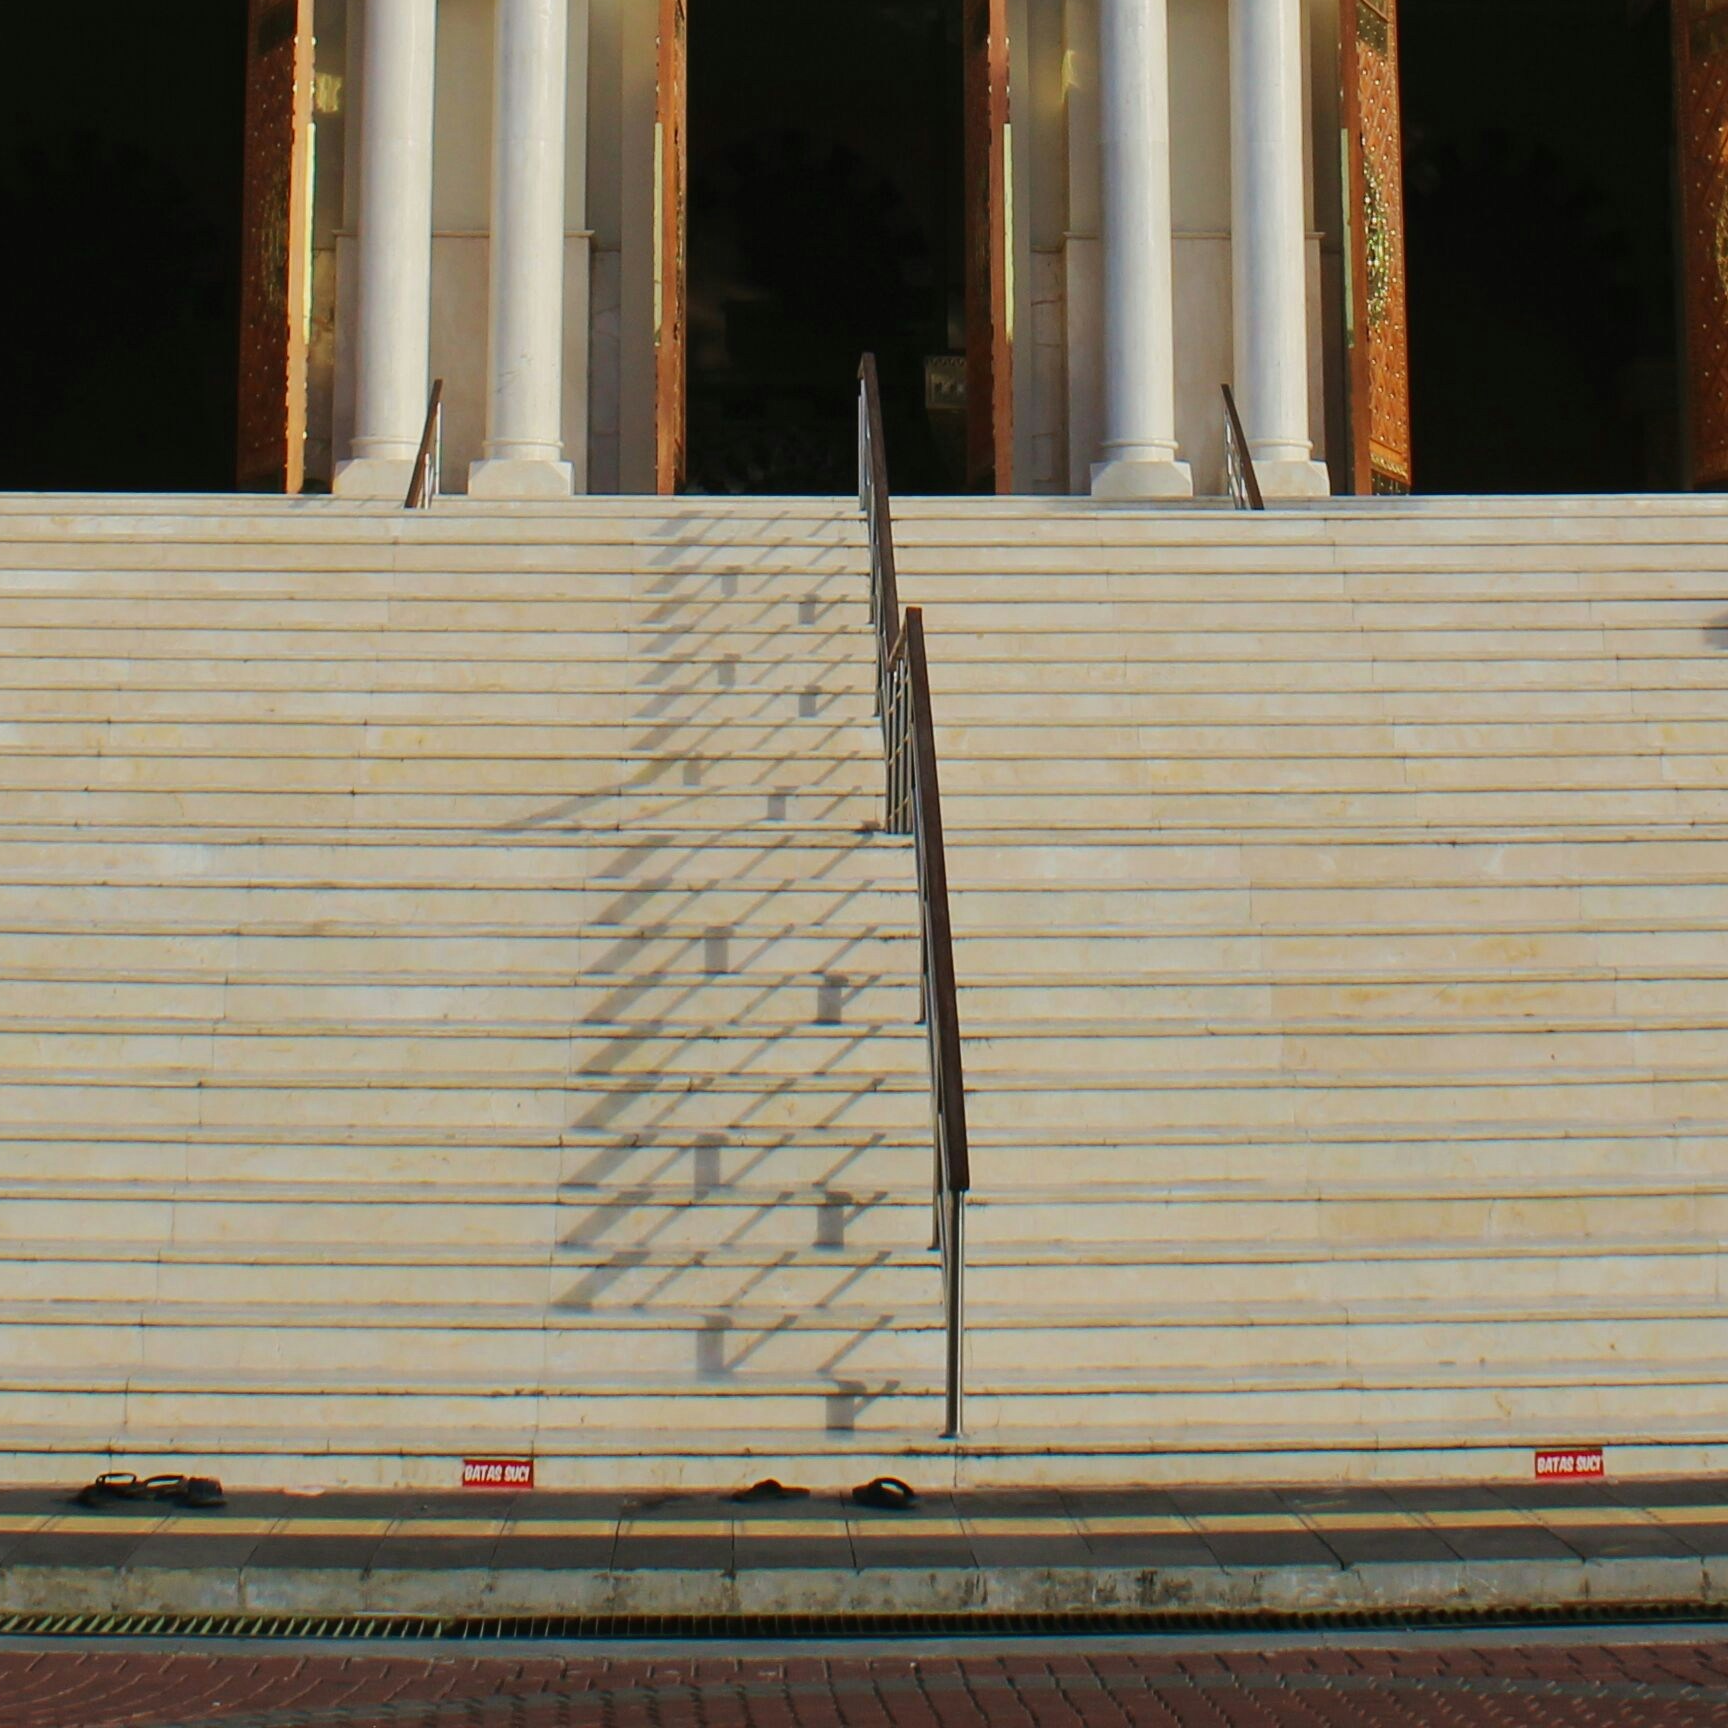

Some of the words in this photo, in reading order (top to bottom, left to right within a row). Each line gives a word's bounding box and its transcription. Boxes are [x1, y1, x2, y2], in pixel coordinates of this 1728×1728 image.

[1537, 1456, 1574, 1473] BATAS
[1575, 1455, 1601, 1473] SUCI
[464, 1465, 502, 1482] BATAS
[504, 1465, 530, 1482] SUCI
